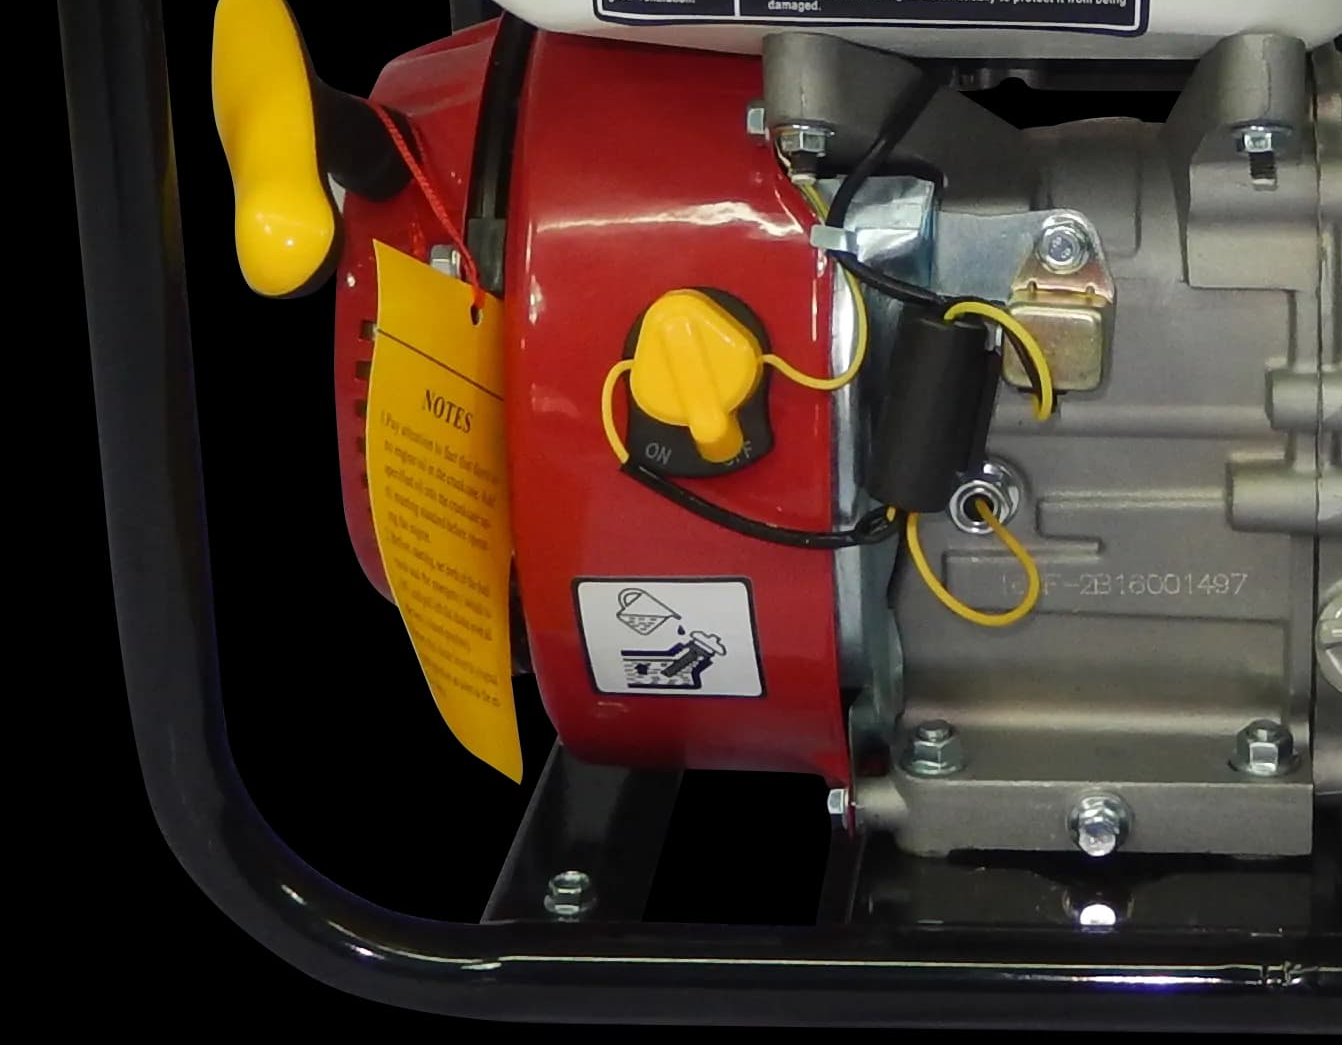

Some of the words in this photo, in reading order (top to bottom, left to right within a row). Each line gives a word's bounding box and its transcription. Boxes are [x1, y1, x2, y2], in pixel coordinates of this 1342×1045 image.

[767, 0, 822, 12] damaged.
[422, 389, 474, 434] NOTES
[645, 442, 673, 465] ON
